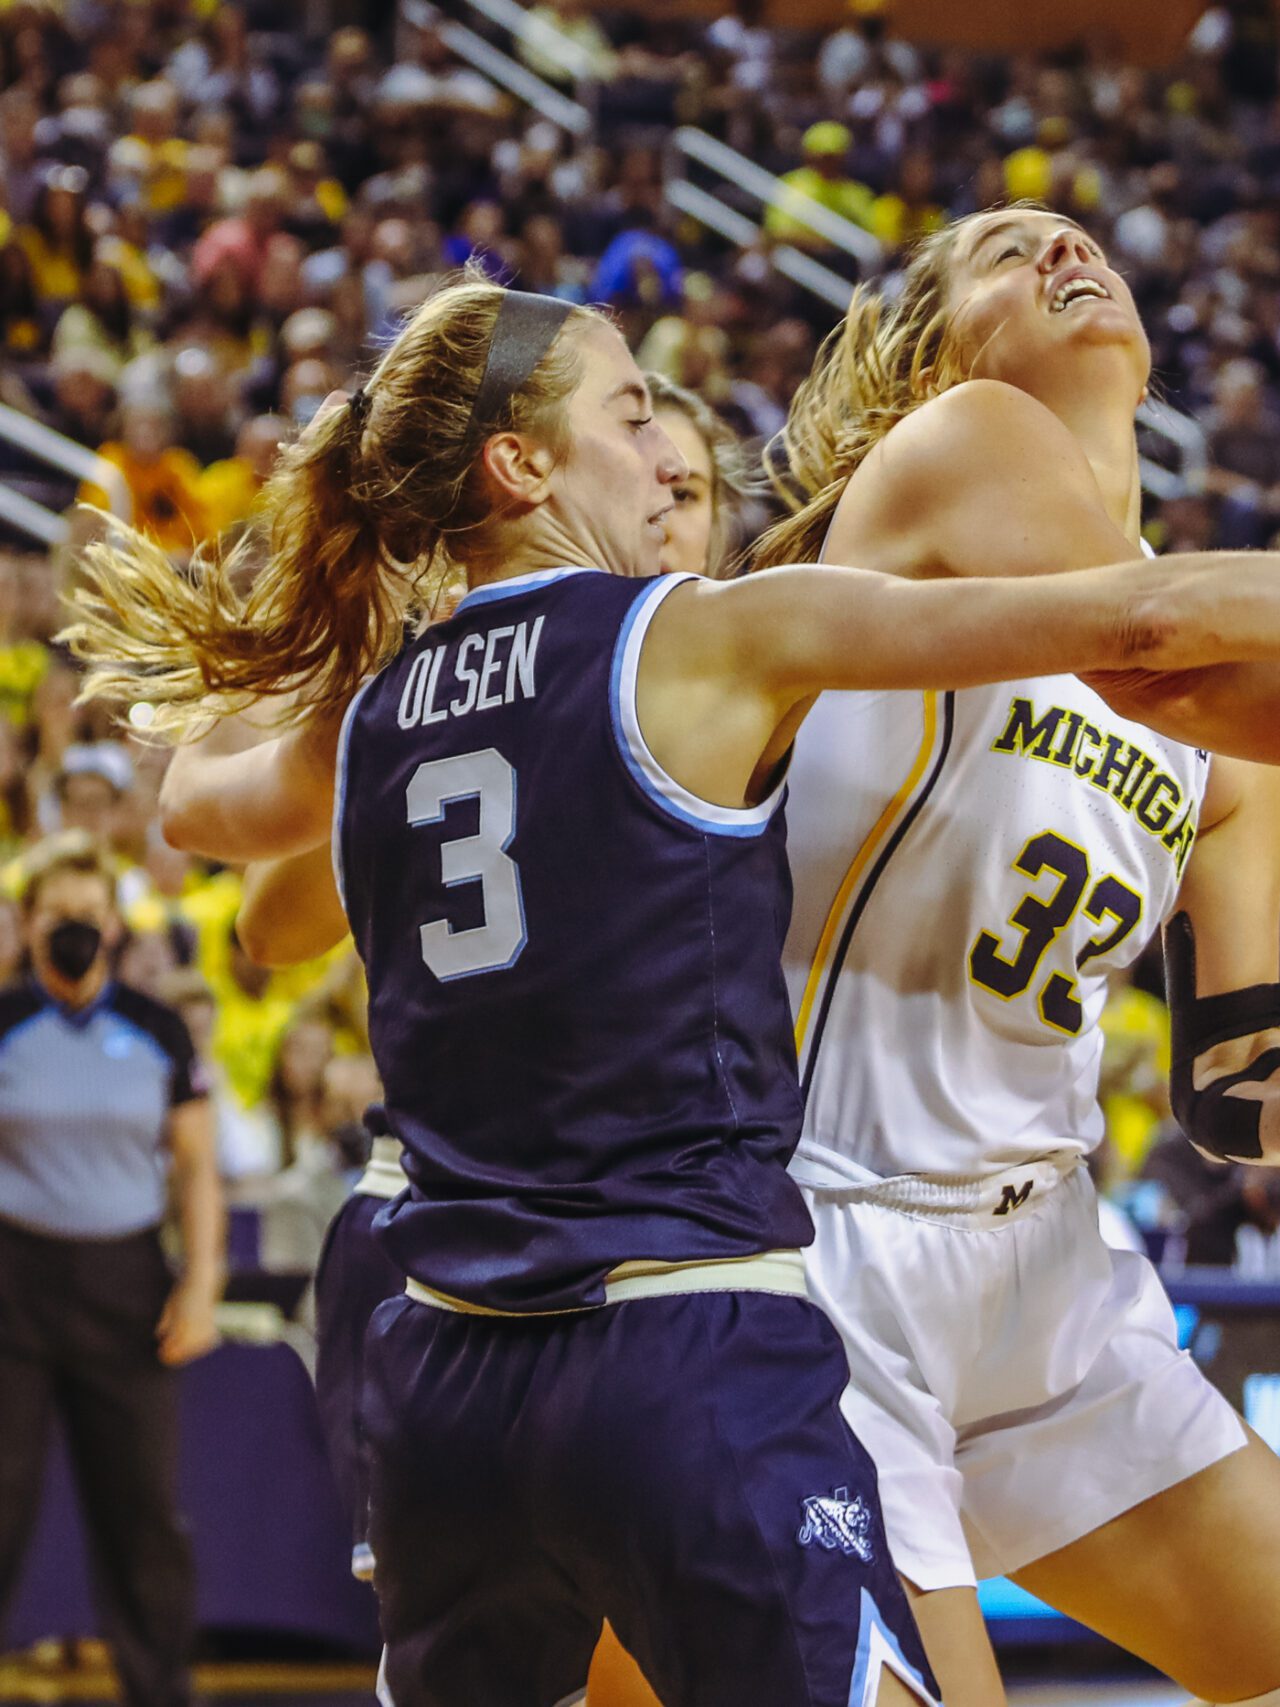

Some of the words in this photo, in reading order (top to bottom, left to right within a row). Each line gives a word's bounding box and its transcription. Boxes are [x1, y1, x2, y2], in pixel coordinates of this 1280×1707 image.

[397, 615, 546, 730] OLSEN
[990, 697, 1195, 878] MICHIGA
[406, 747, 529, 984] 3
[992, 1179, 1034, 1216] M
